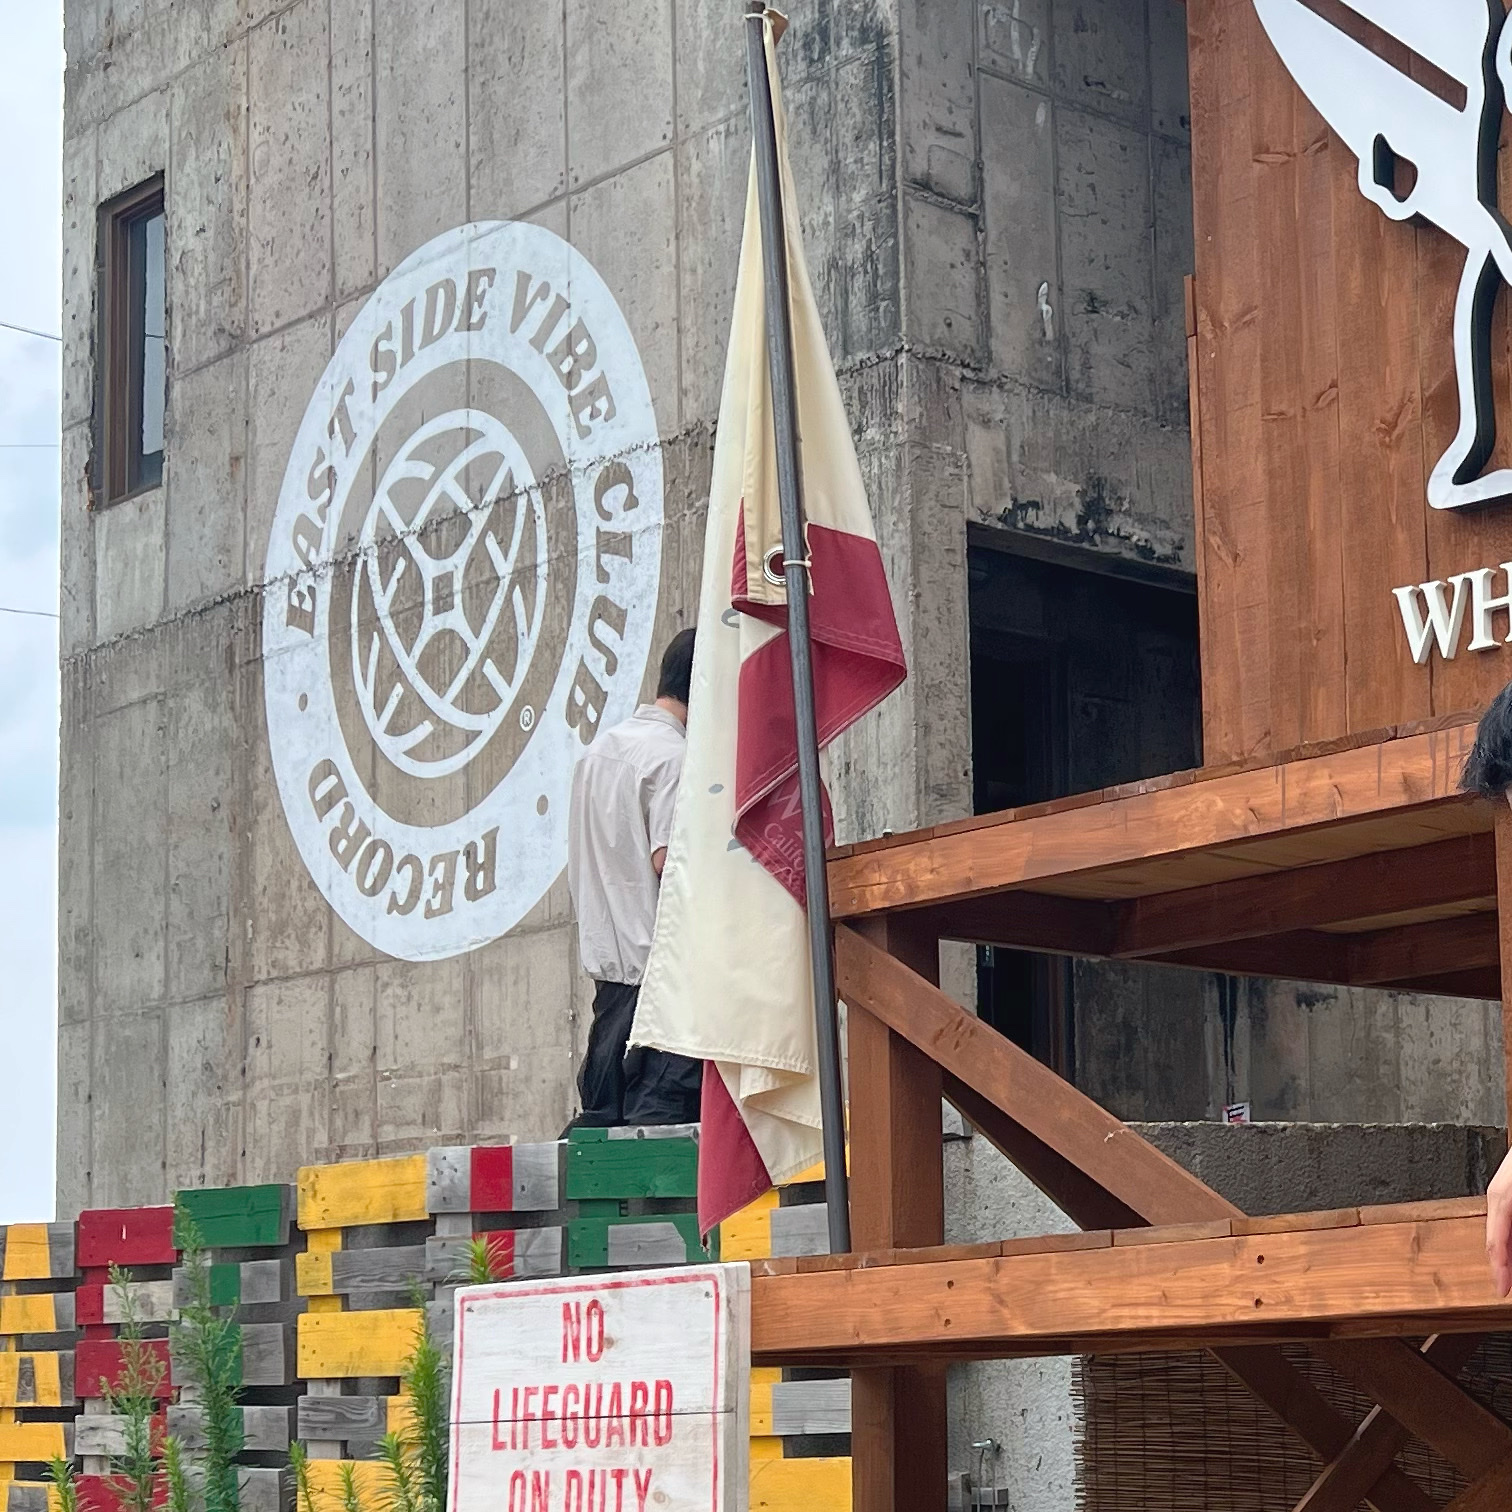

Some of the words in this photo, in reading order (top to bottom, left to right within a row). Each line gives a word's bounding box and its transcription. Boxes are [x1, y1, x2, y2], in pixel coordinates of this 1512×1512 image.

[286, 377, 358, 638] EAST
[370, 267, 497, 402] SIDE
[509, 269, 617, 440] VIBE
[565, 462, 639, 746] CLUB
[308, 758, 500, 920] RECORD
[562, 1299, 605, 1364] NO
[491, 1379, 674, 1451] LIFEGUARD
